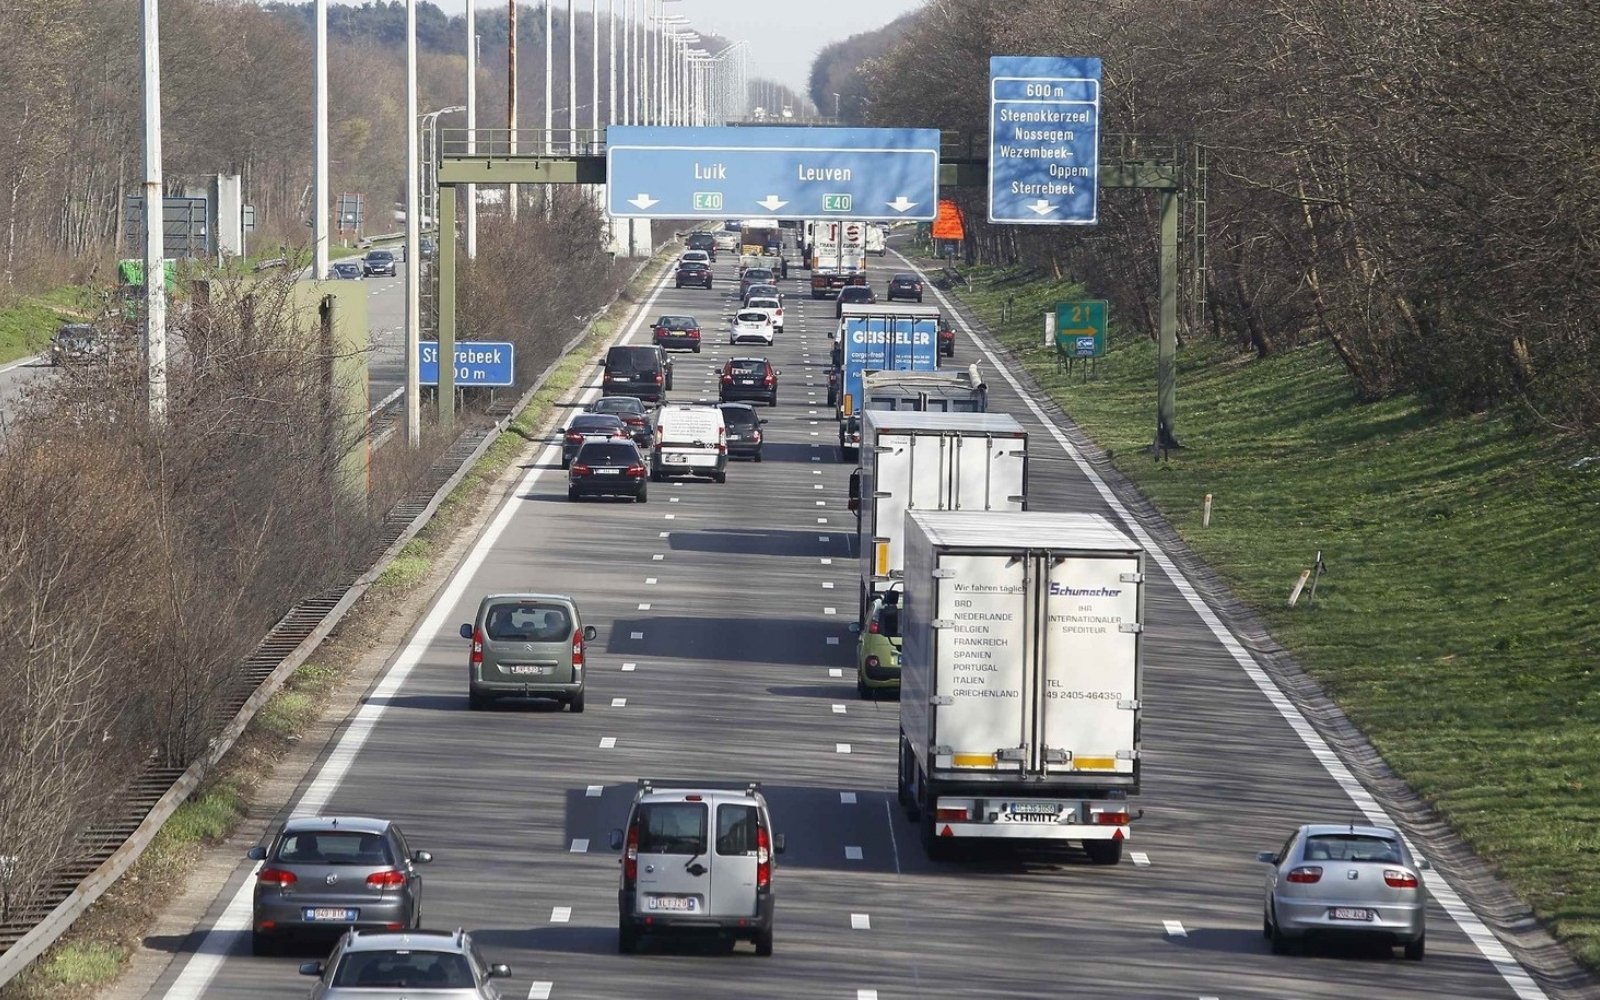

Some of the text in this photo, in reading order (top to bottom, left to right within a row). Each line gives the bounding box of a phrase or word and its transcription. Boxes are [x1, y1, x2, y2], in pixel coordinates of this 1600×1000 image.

[1026, 84, 1064, 97] 600 m
[1000, 109, 1090, 122] Steenokkerzeel
[1015, 128, 1074, 143] Nossegem
[1000, 145, 1074, 159] Wezembeek-
[695, 163, 726, 179] Luik
[799, 164, 851, 181] Leuven
[1049, 164, 1089, 179] Oppem
[1011, 181, 1076, 195] Sterrebeek
[1072, 306, 1091, 323] 21
[852, 330, 931, 345] GEISSELER
[423, 347, 502, 364] Strebeek
[473, 370, 486, 379] m
[954, 583, 969, 591] Wir
[971, 584, 998, 592] fahren
[1050, 582, 1122, 597] Schumacher
[954, 600, 972, 608] BRD
[954, 612, 1013, 621] NIEDERLANDE
[1048, 615, 1122, 624] INTERNATIONALER
[954, 625, 990, 634] BELGIEN
[1062, 626, 1106, 634] SPEDITEUR
[954, 638, 1008, 647] FRANKREICH
[953, 651, 992, 659] SPANIEN
[953, 664, 998, 672] PORTUGAL
[953, 676, 985, 684] ITALIEN
[953, 689, 1019, 698] GRIECHENLAND
[1004, 812, 1061, 822] SCHMITZ
